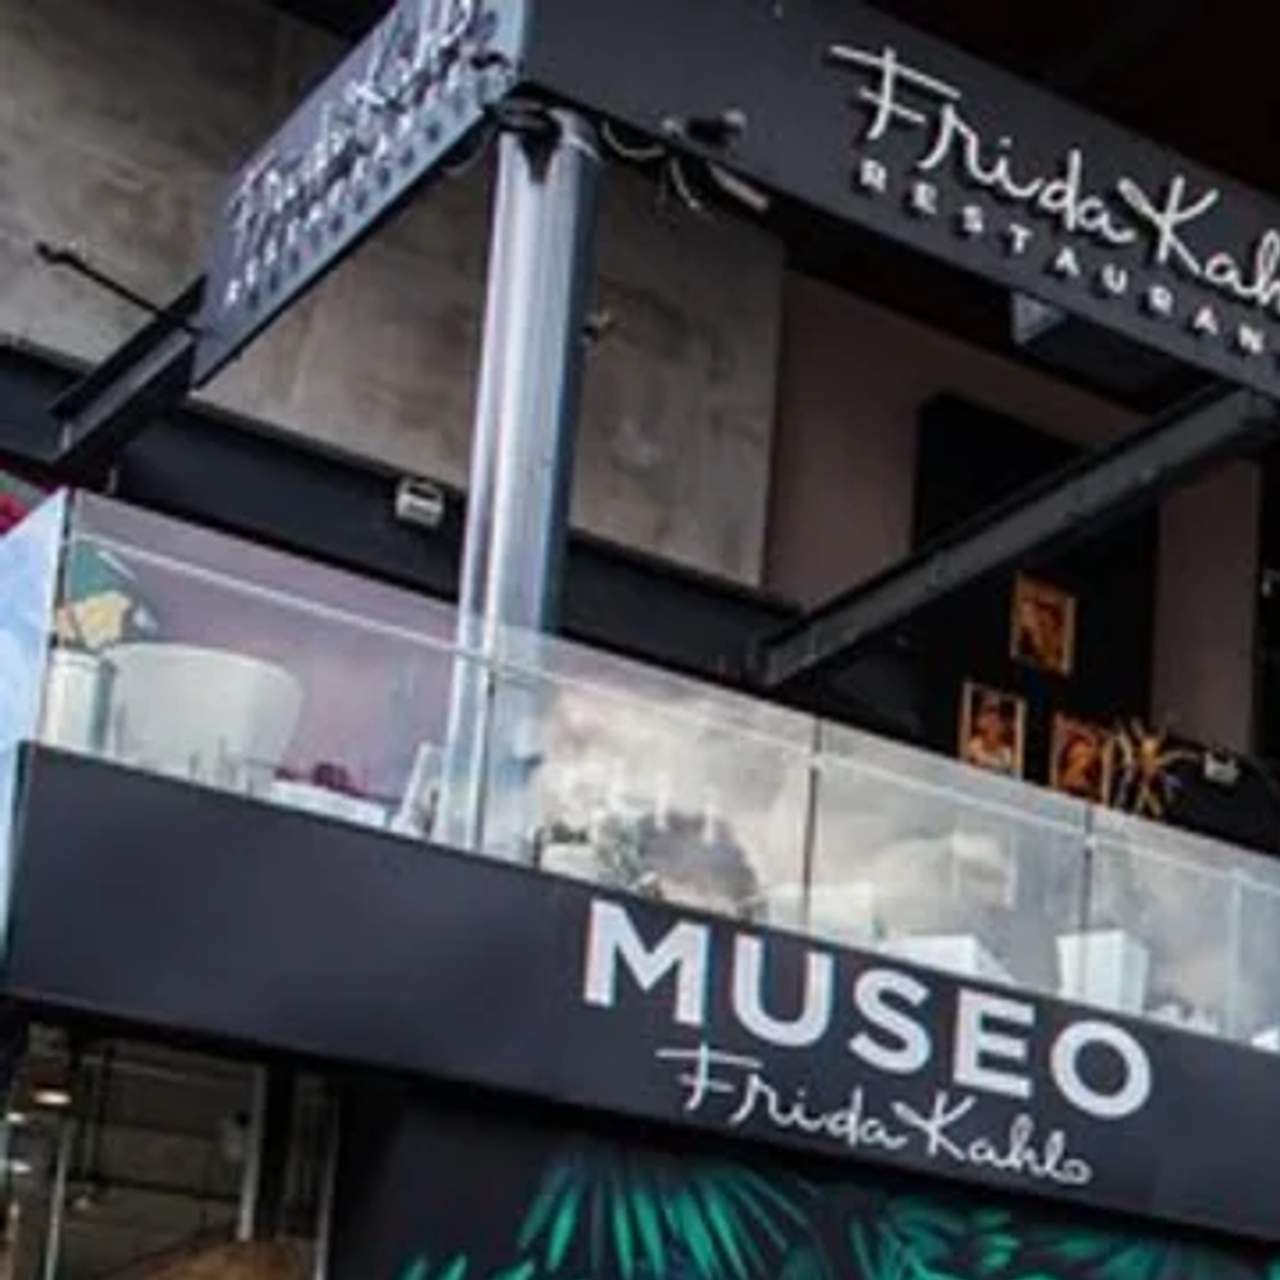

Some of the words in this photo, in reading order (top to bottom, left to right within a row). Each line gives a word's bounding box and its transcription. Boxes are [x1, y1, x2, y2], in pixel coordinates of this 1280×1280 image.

[831, 45, 1138, 248] Frida
[583, 898, 1152, 1119] MUSEO
[656, 1042, 907, 1150] Frida
[893, 1090, 1092, 1186] Kahlo
